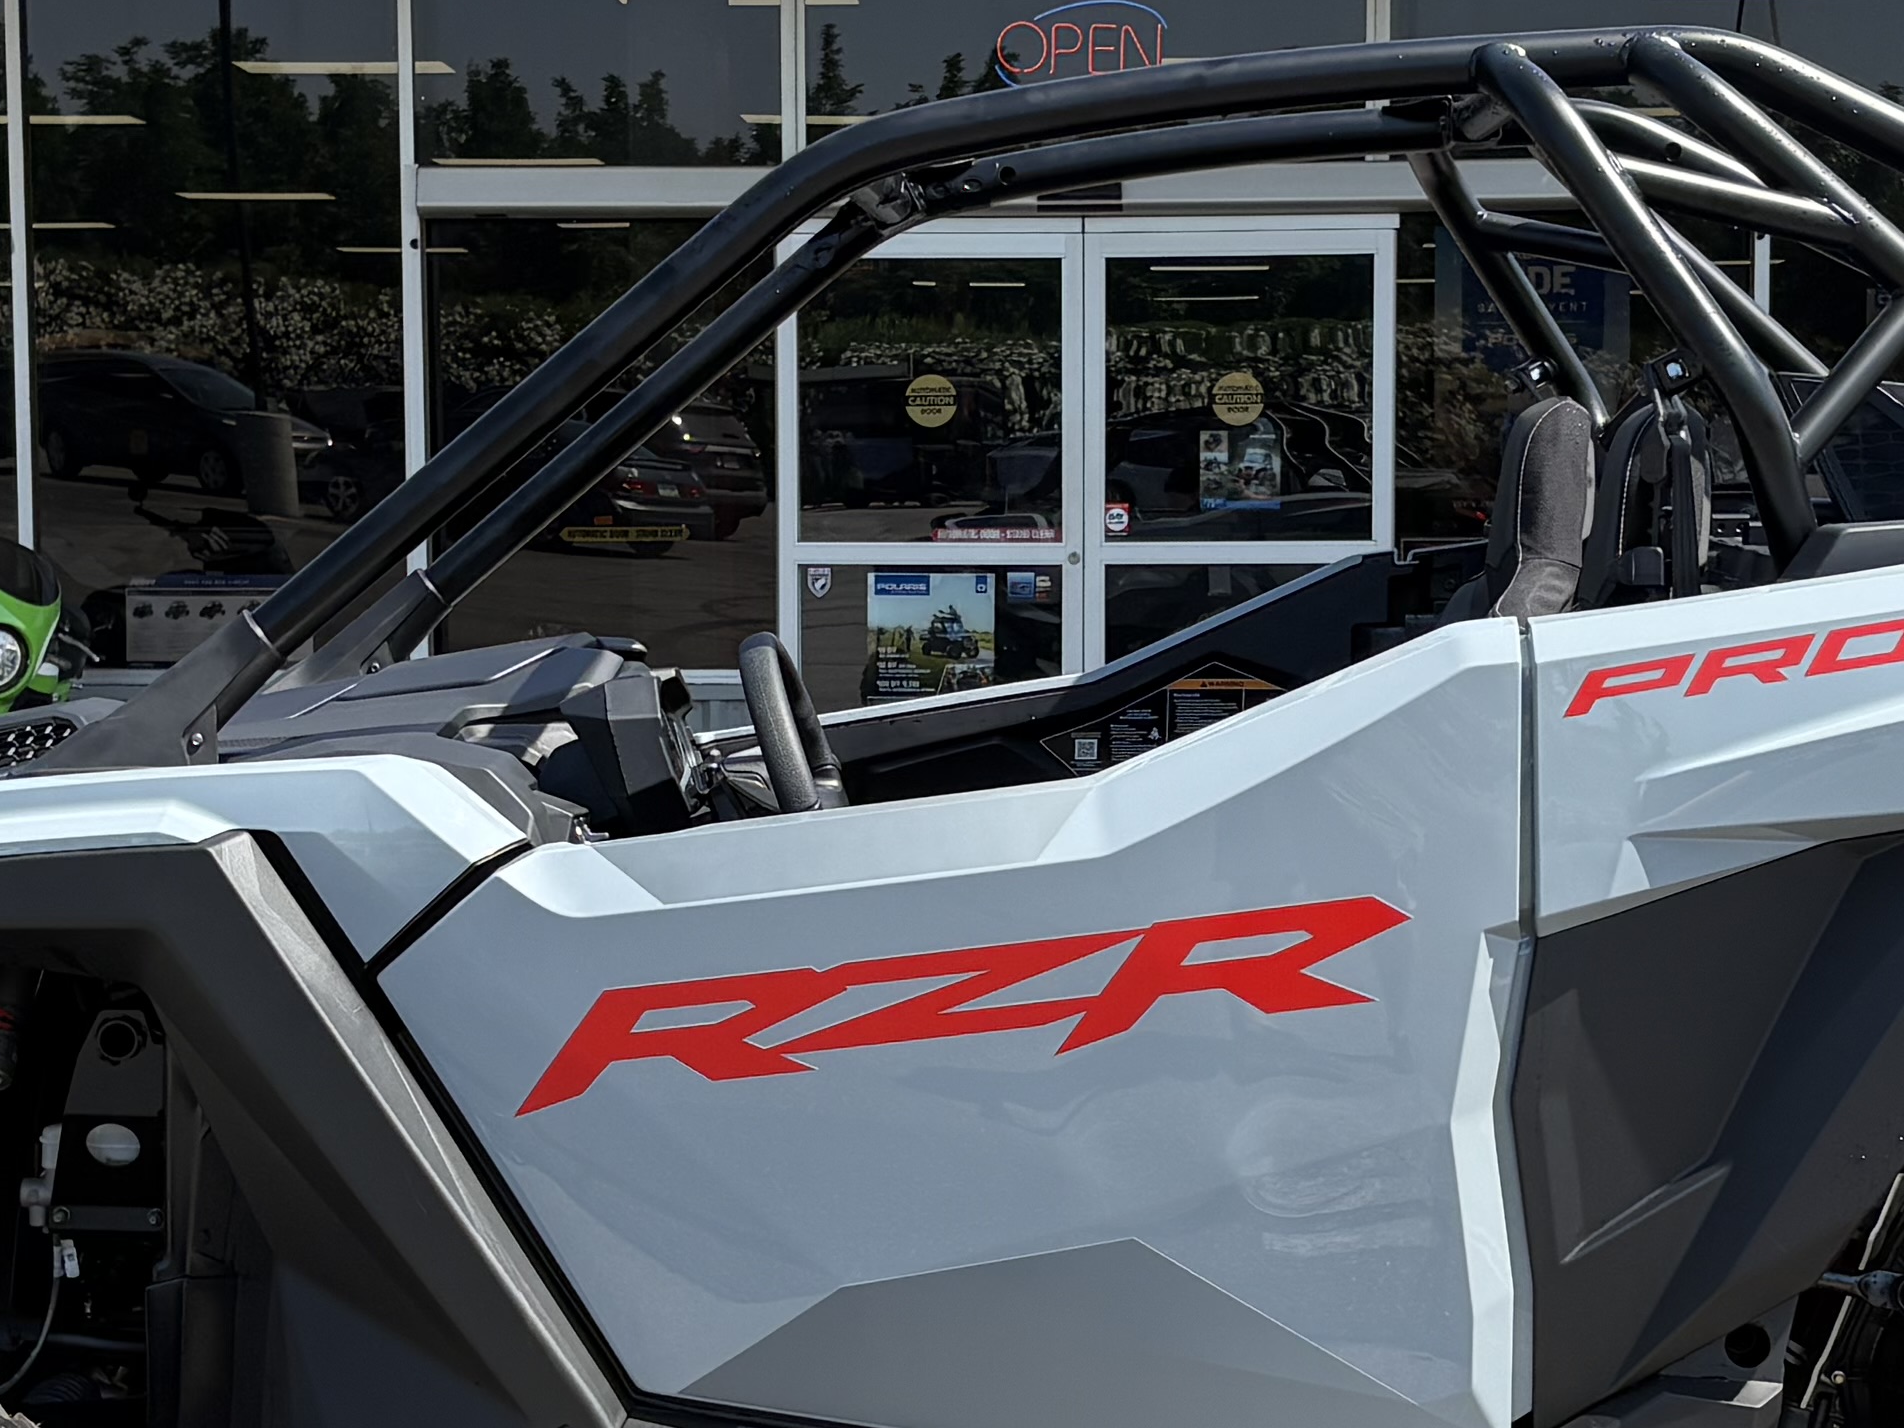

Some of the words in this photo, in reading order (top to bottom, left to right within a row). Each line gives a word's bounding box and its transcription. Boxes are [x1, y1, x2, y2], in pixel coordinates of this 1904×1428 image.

[997, 21, 1163, 75] OPEN
[1527, 265, 1576, 295] DE
[908, 396, 954, 406] CAUTION
[1215, 394, 1262, 404] CAUTION
[876, 582, 927, 592] POLARIS
[514, 893, 1414, 1118] RZR
